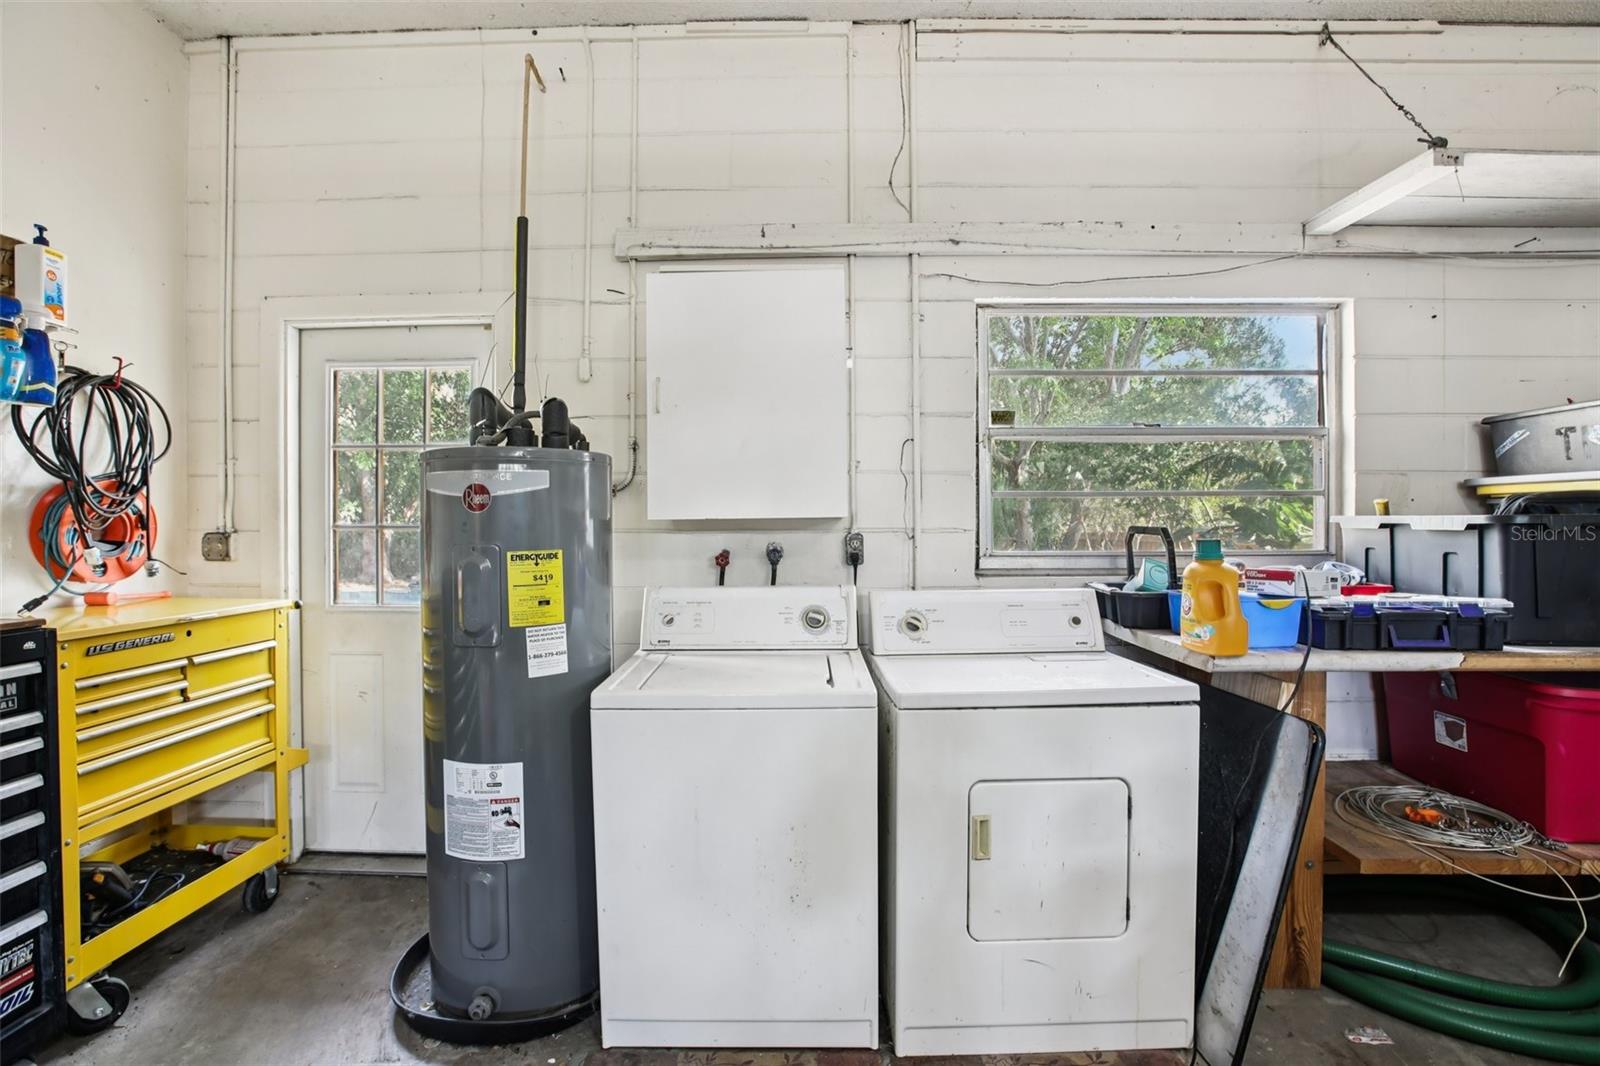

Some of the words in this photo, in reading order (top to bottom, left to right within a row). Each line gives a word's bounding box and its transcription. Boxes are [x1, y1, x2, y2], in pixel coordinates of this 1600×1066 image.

[465, 484, 489, 509] Rheem
[533, 574, 553, 583] $419
[115, 632, 175, 651] GENERAL
